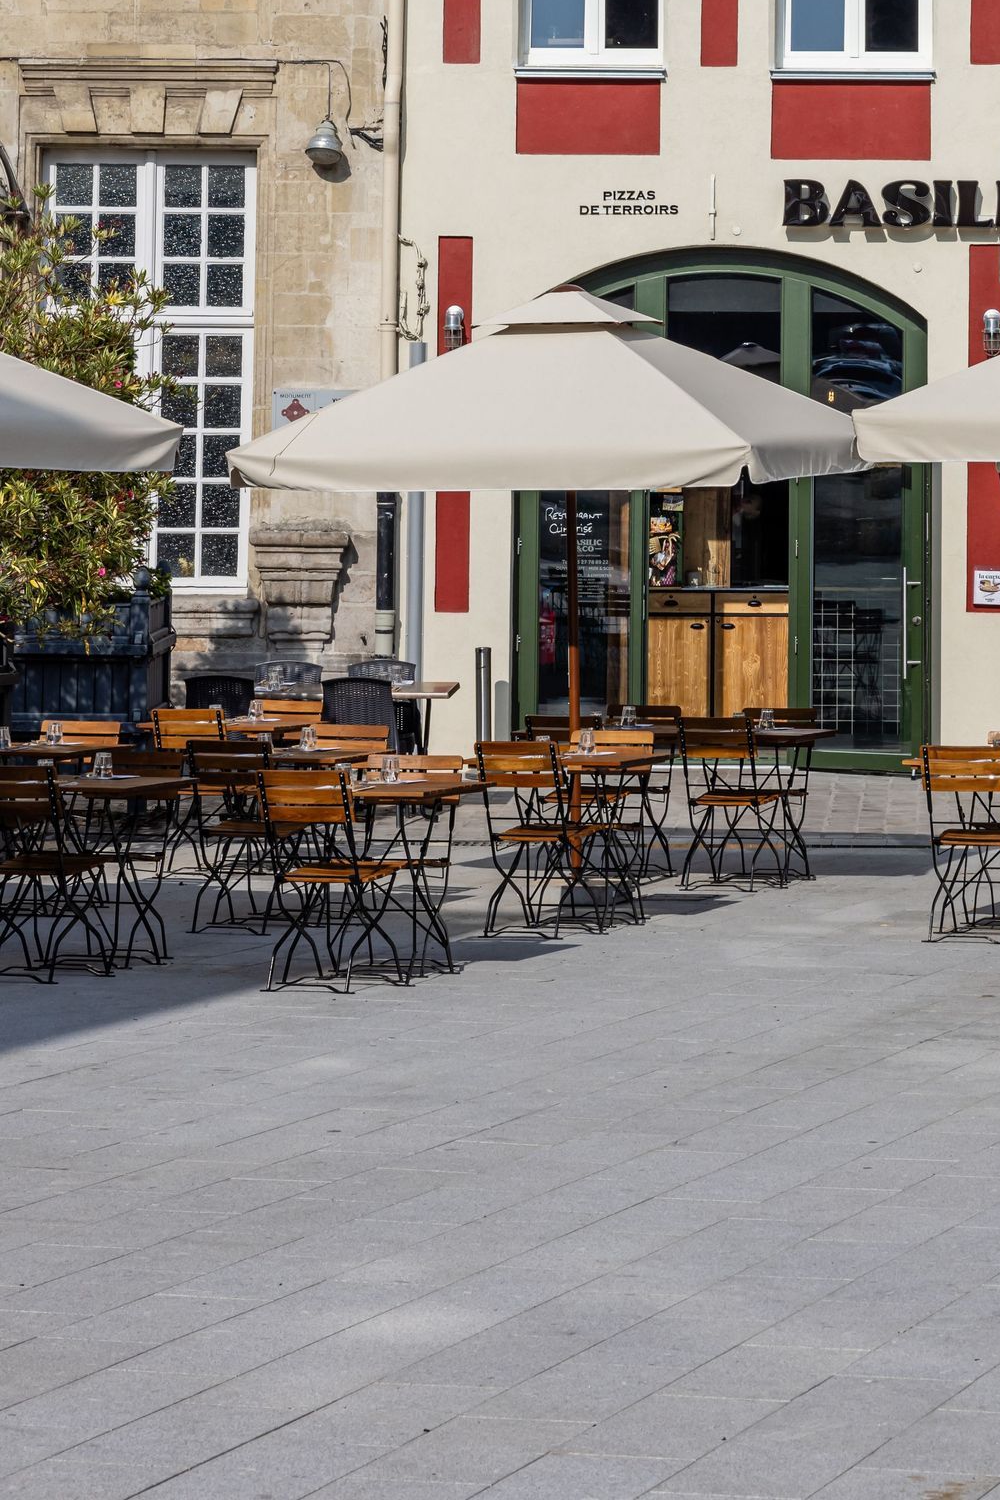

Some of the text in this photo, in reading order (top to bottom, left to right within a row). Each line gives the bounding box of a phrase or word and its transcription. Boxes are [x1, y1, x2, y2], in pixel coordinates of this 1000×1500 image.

[603, 190, 656, 201] PIZZAS
[579, 205, 679, 215] DE TERROIRS
